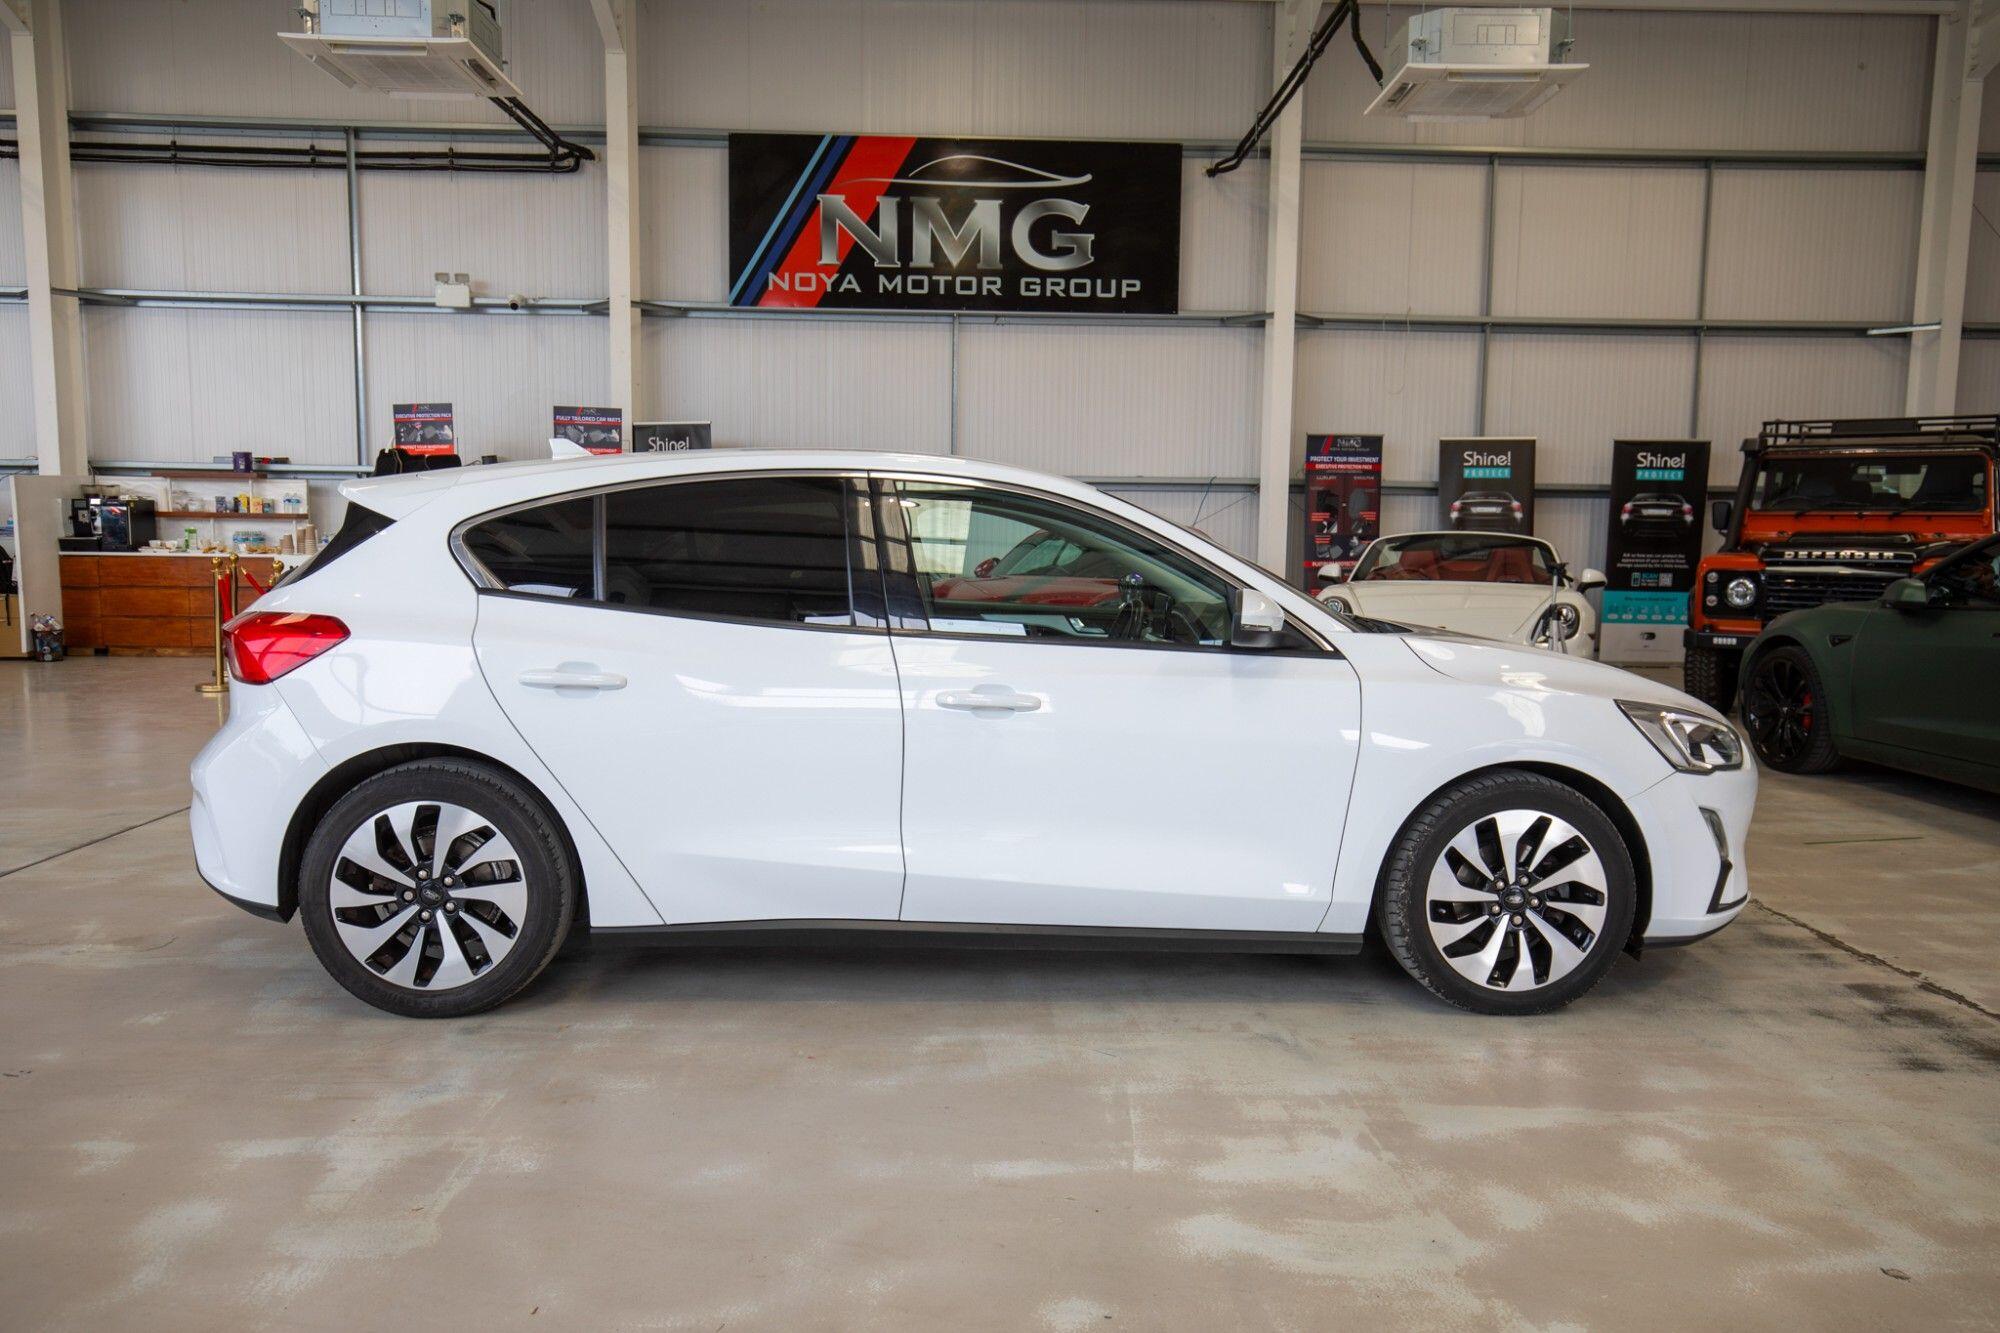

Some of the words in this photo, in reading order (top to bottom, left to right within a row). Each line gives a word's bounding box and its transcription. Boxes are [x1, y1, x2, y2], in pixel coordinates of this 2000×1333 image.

[816, 194, 1095, 271] NMG
[768, 272, 861, 293] NOYA
[878, 275, 1002, 296] MOTOR
[1020, 277, 1141, 298] GROUP
[1463, 451, 1511, 466] Shine!
[1636, 452, 1686, 468] Shine!
[1637, 469, 1683, 479] PROTECT
[1784, 550, 1895, 559] DEFENDER
